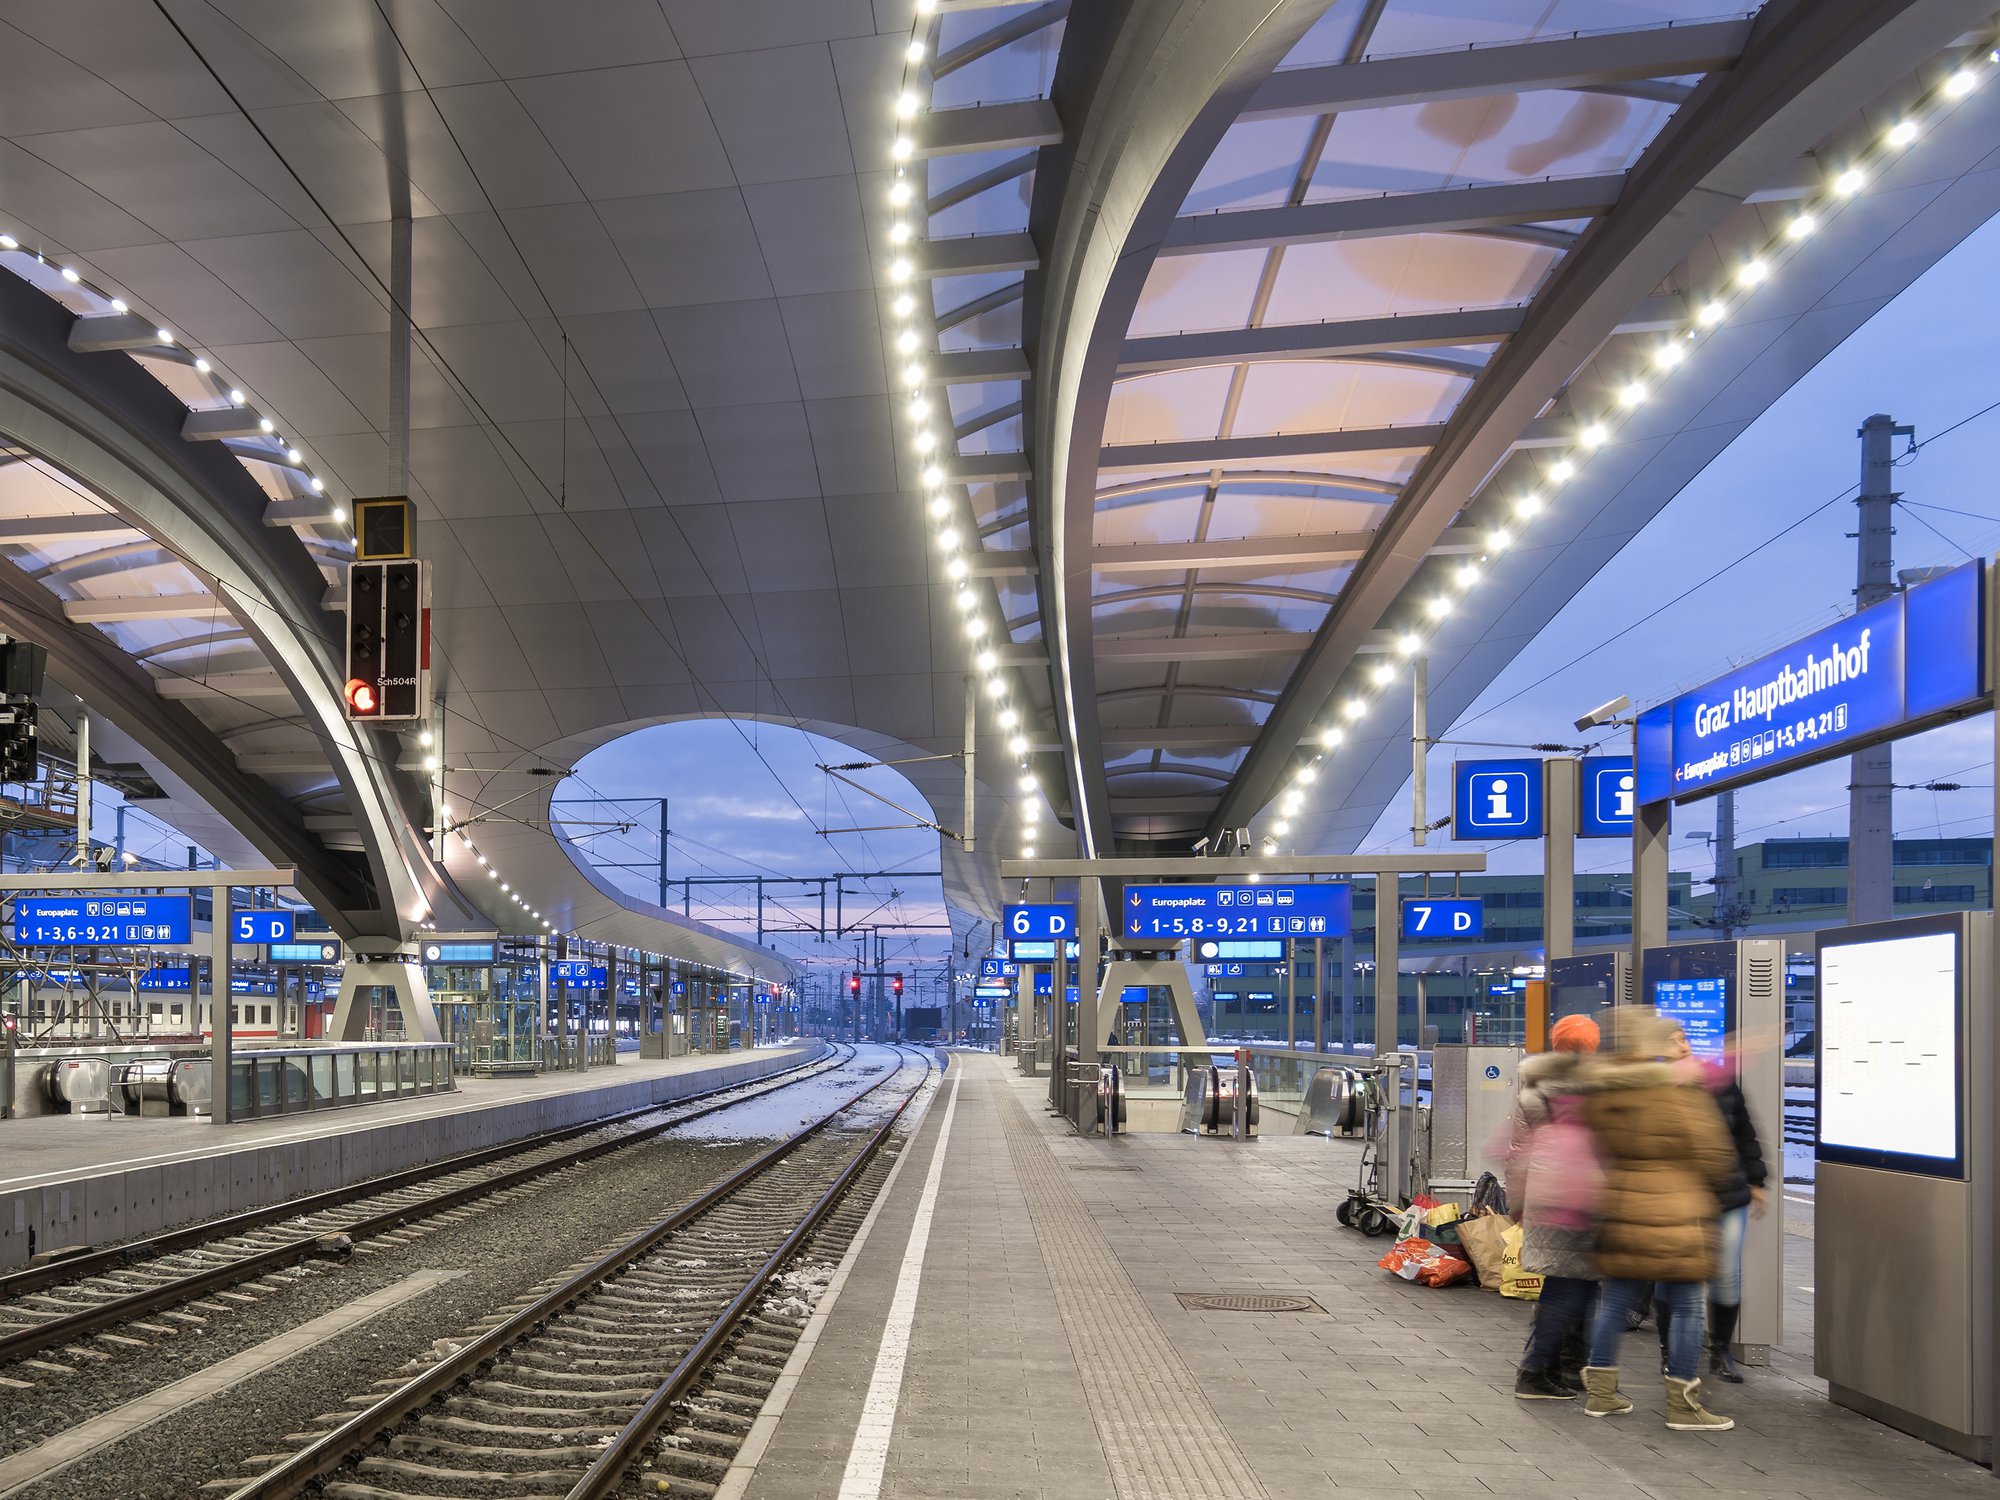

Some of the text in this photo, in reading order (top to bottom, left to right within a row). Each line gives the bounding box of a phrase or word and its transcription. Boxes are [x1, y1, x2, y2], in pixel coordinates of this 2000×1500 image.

[377, 677, 416, 686] Sch504R
[1695, 628, 1871, 738] Graz Hauptbahnhof
[1684, 751, 1729, 780] Europaplatz
[36, 908, 79, 918] Europaplatz
[1152, 898, 1206, 908] Europaplatz
[240, 916, 285, 939] 5 D
[1013, 910, 1066, 934] 6 D
[1413, 907, 1471, 931] 7 D
[1517, 1279, 1539, 1287] BILLA
